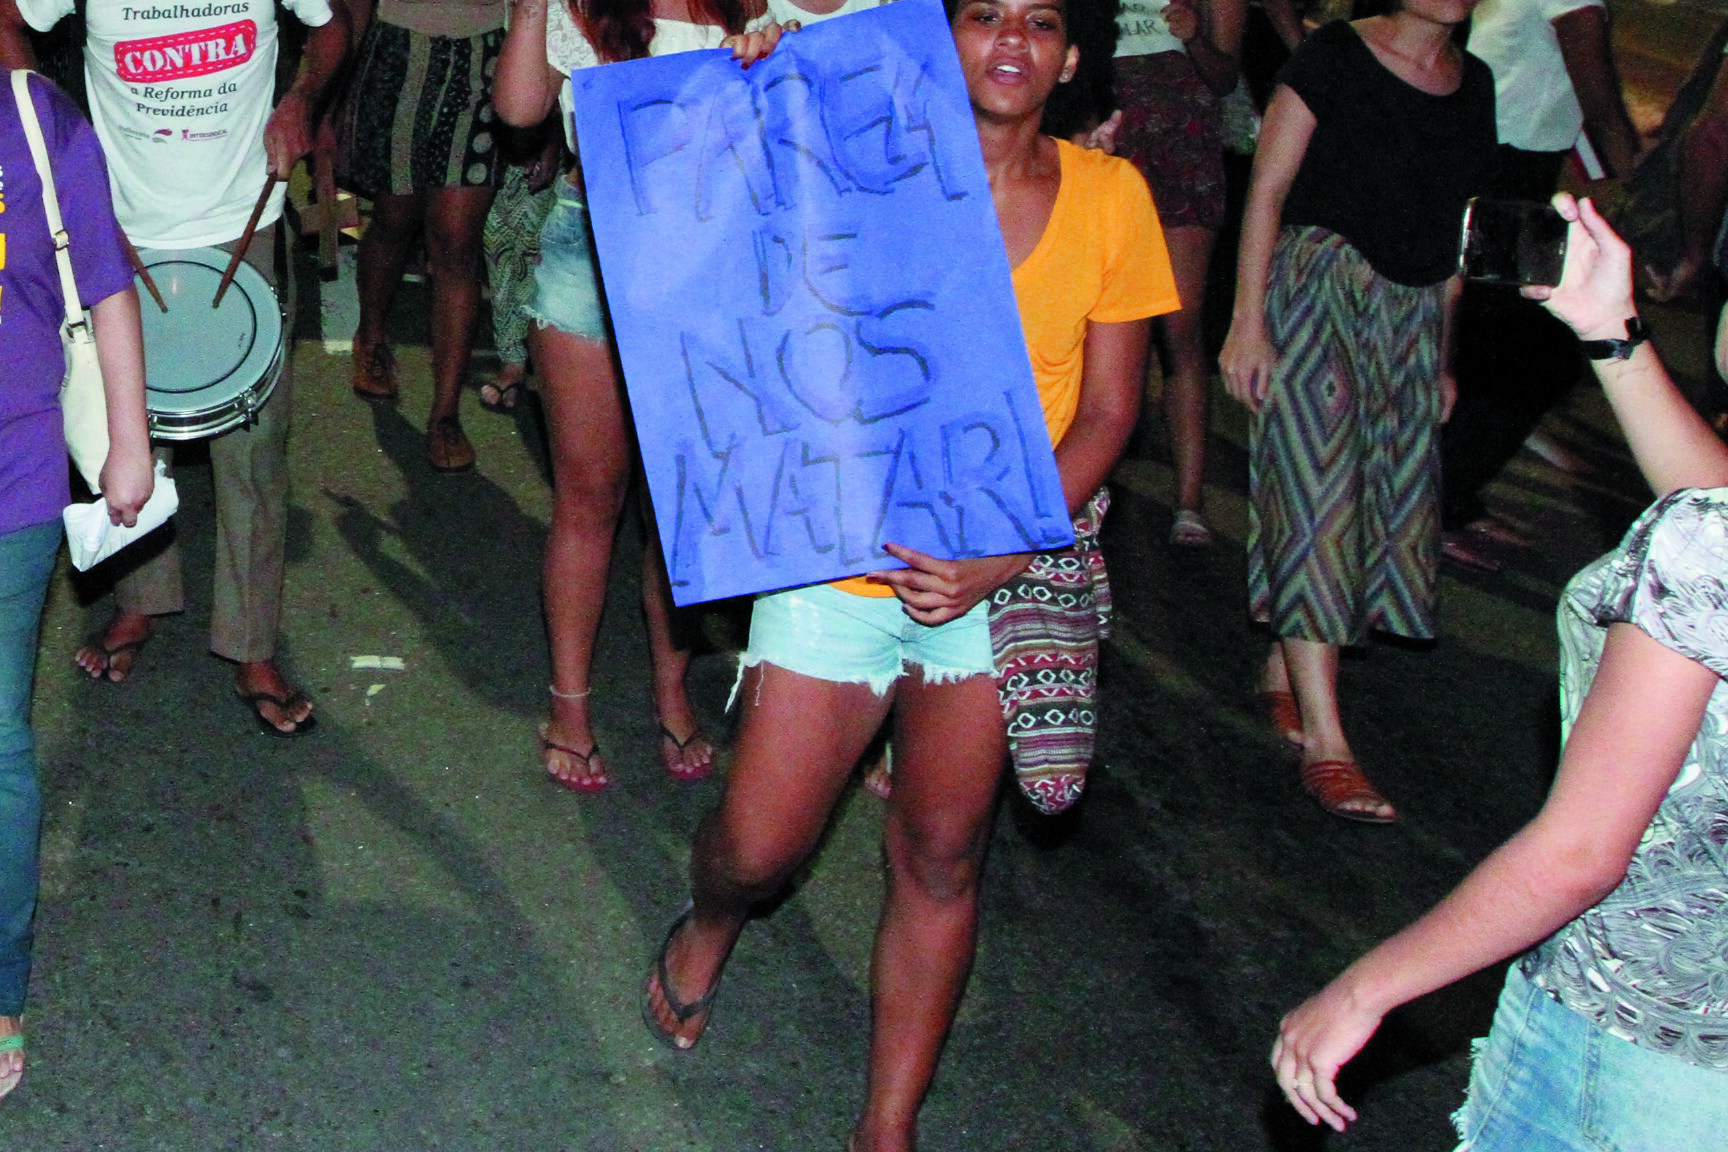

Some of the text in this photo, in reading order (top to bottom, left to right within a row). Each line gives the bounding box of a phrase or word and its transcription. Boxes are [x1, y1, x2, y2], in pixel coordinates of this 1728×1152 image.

[122, 1, 249, 21] Trabalhadoras
[124, 32, 247, 74] CONTRA
[143, 85, 213, 102] Reforma
[217, 80, 237, 95] da
[136, 101, 228, 117] Previdência
[680, 298, 936, 459] NOS
